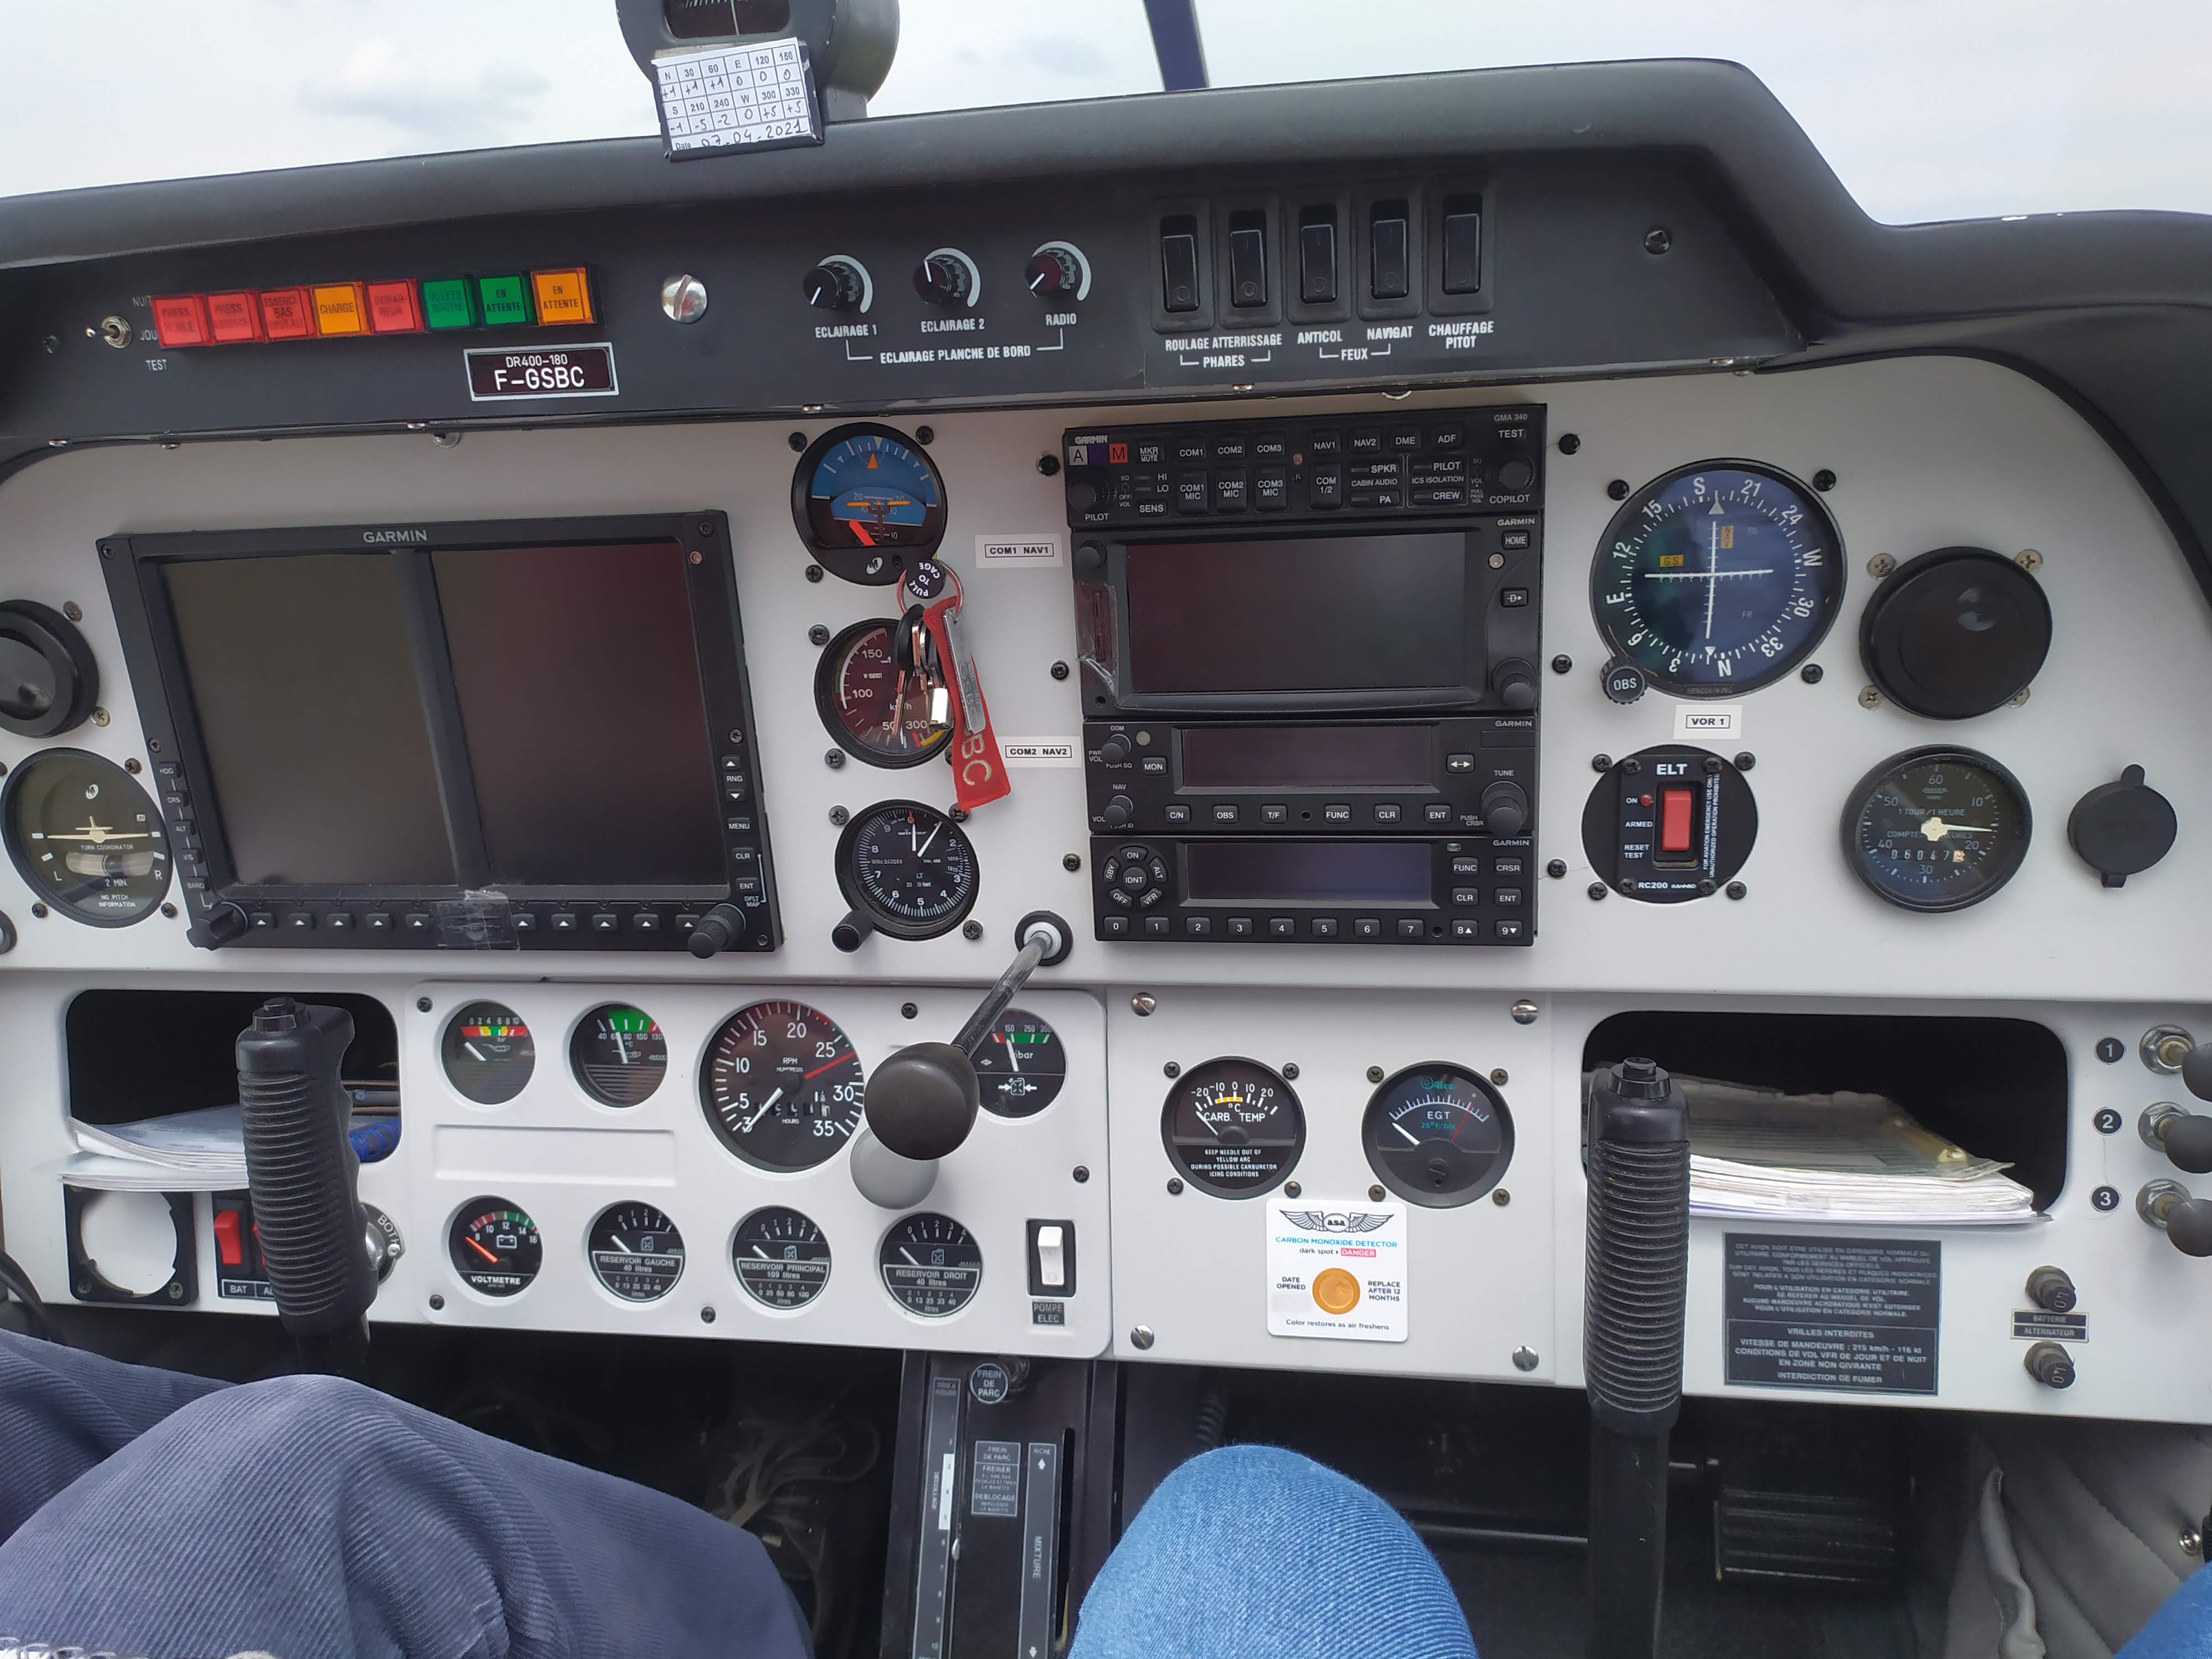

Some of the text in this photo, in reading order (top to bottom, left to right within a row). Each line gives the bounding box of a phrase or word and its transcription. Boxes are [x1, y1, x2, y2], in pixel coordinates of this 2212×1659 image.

[665, 51, 793, 80] N 30 60 E 120 150
[495, 289, 507, 300] EN
[552, 285, 564, 295] EN
[320, 302, 354, 315] CHARGE
[486, 302, 523, 312] ATTENTE
[543, 298, 579, 309] ATTENTE
[921, 318, 985, 332] ECLAIRAGE 2
[1046, 314, 1077, 326] RADIO
[815, 325, 878, 338] ECLAIRAGE 1
[1367, 326, 1412, 340] NAVIGAT
[1428, 322, 1494, 337] CHAUFFAGE
[1165, 334, 1282, 351] ROULAGE ATTERRISSAGE
[1297, 331, 1342, 344] ANTICOL
[1446, 337, 1475, 349] PITOT
[880, 346, 1030, 364] ECLAIRAGE PLANCHE DE BORD
[1341, 349, 1368, 361] FEUX
[146, 359, 167, 372] TEST
[505, 354, 568, 368] DR400-180
[1203, 356, 1245, 368] PHARES
[494, 367, 585, 390] F-GSBC
[1438, 434, 1456, 444] ADF
[1498, 429, 1524, 438] TEST
[1314, 441, 1336, 450] NAV1
[1354, 438, 1376, 447] NAV2
[1395, 436, 1416, 445] DME
[1139, 447, 1158, 456] MKR
[1179, 448, 1203, 457] COM1
[1217, 446, 1242, 455] COM2
[1256, 444, 1282, 453] COM3
[1370, 465, 1396, 473] SPKR
[1433, 462, 1461, 471] PILOT
[1741, 479, 1762, 497] 21
[1432, 491, 1460, 500] CREW
[1489, 494, 1530, 504] COPILOT
[1139, 504, 1164, 513] SENS
[1085, 513, 1109, 521] PILOT
[363, 530, 427, 543] GARMIN
[1505, 536, 1526, 545] HOME
[1613, 678, 1637, 690] OBS
[1692, 717, 1725, 726] VOR 1
[1656, 763, 1687, 775] ELT
[1430, 811, 1446, 820] ENT
[787, 1023, 806, 1038] 20
[816, 1042, 835, 1057] 25
[2106, 1045, 2114, 1057] 1
[1240, 1113, 1265, 1122] TEMP
[1427, 1110, 1451, 1119] EGT
[2103, 1116, 2113, 1128] 2
[813, 1120, 834, 1136] 35
[2100, 1193, 2110, 1205] 3
[600, 1255, 676, 1267] RESERVOIR GAUCHE
[742, 1262, 825, 1273] RESERVOIR PRINCIPAL
[896, 1269, 967, 1280] RESERVOIR DROIT
[471, 1276, 520, 1285] VOLTMETRE
[1034, 1304, 1062, 1313] POMPE
[1038, 1314, 1060, 1323] ELEC
[2033, 1314, 2067, 1323] BATTERIE
[1825, 1330, 1874, 1338] INTERDITES
[2024, 1327, 2075, 1337] ALTERNATEUR
[1778, 1372, 1836, 1381] INTERDICTION
[1853, 1375, 1882, 1383] FUMER
[978, 1389, 1000, 1397] PARC
[1032, 1536, 1042, 1579] MIXTURE
